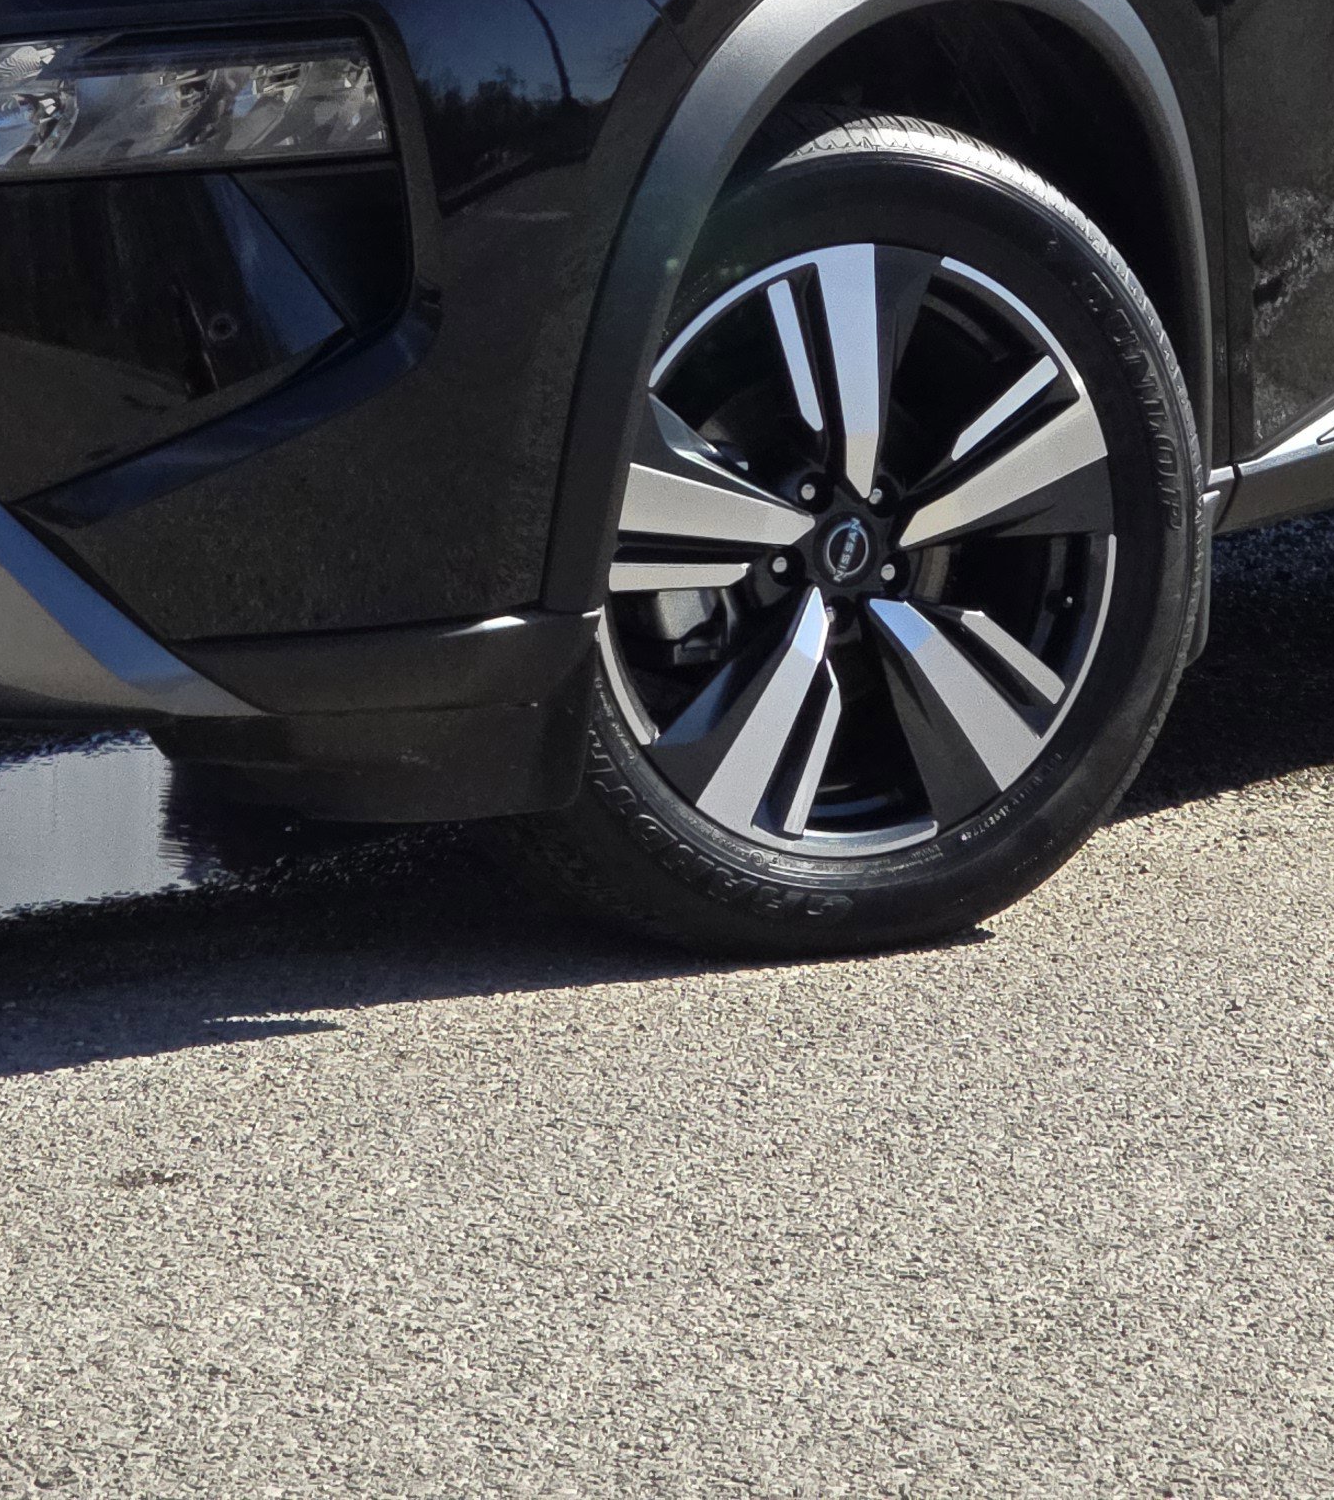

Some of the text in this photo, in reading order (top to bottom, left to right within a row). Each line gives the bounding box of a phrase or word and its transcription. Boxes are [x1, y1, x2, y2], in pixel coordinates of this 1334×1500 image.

[1071, 270, 1183, 531] DUNLOP
[833, 517, 861, 583] NISSAN
[585, 722, 855, 922] GRANDTR
